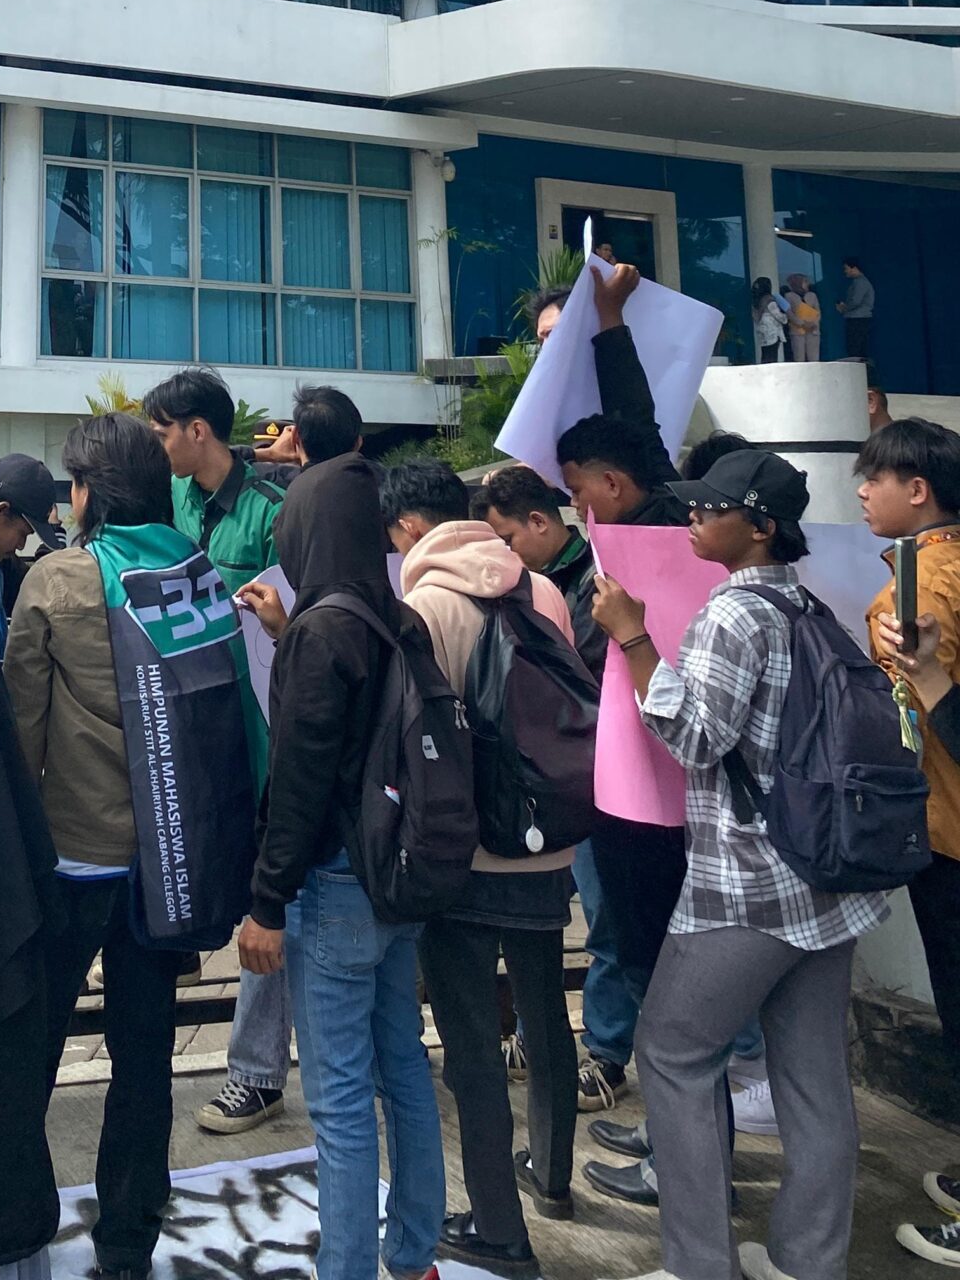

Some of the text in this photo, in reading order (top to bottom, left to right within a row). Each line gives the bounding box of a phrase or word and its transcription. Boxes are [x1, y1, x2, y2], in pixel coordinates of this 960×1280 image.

[135, 665, 177, 922] KOMISARIAT STIT AL-KHAIRIYAH CABANG CILEGON
[147, 664, 192, 920] HIMPUNAN MAHASISWA ISLAM
